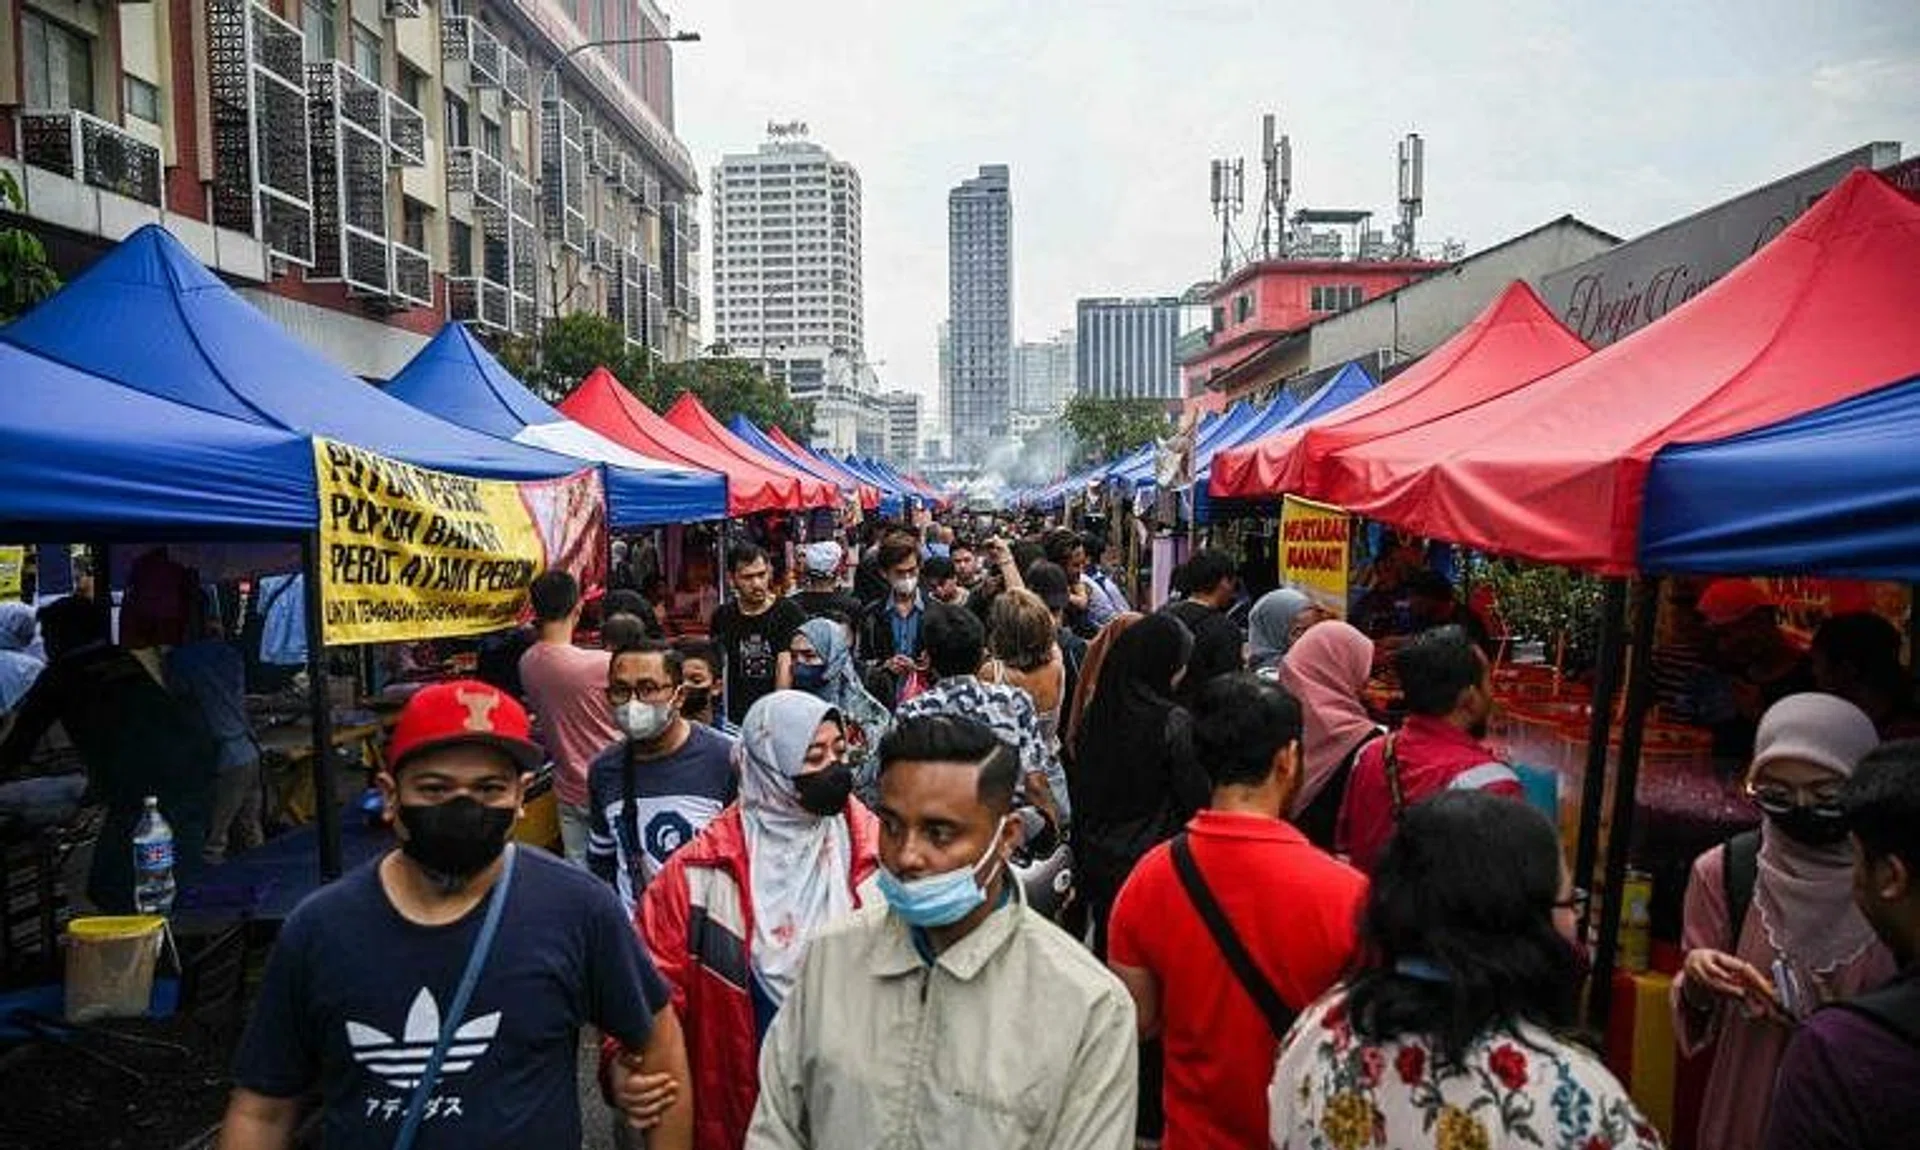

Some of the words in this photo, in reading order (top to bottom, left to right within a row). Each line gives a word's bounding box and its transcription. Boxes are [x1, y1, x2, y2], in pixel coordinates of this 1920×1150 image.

[397, 553, 471, 593] AYAM
[366, 1096, 463, 1120] アデダス
